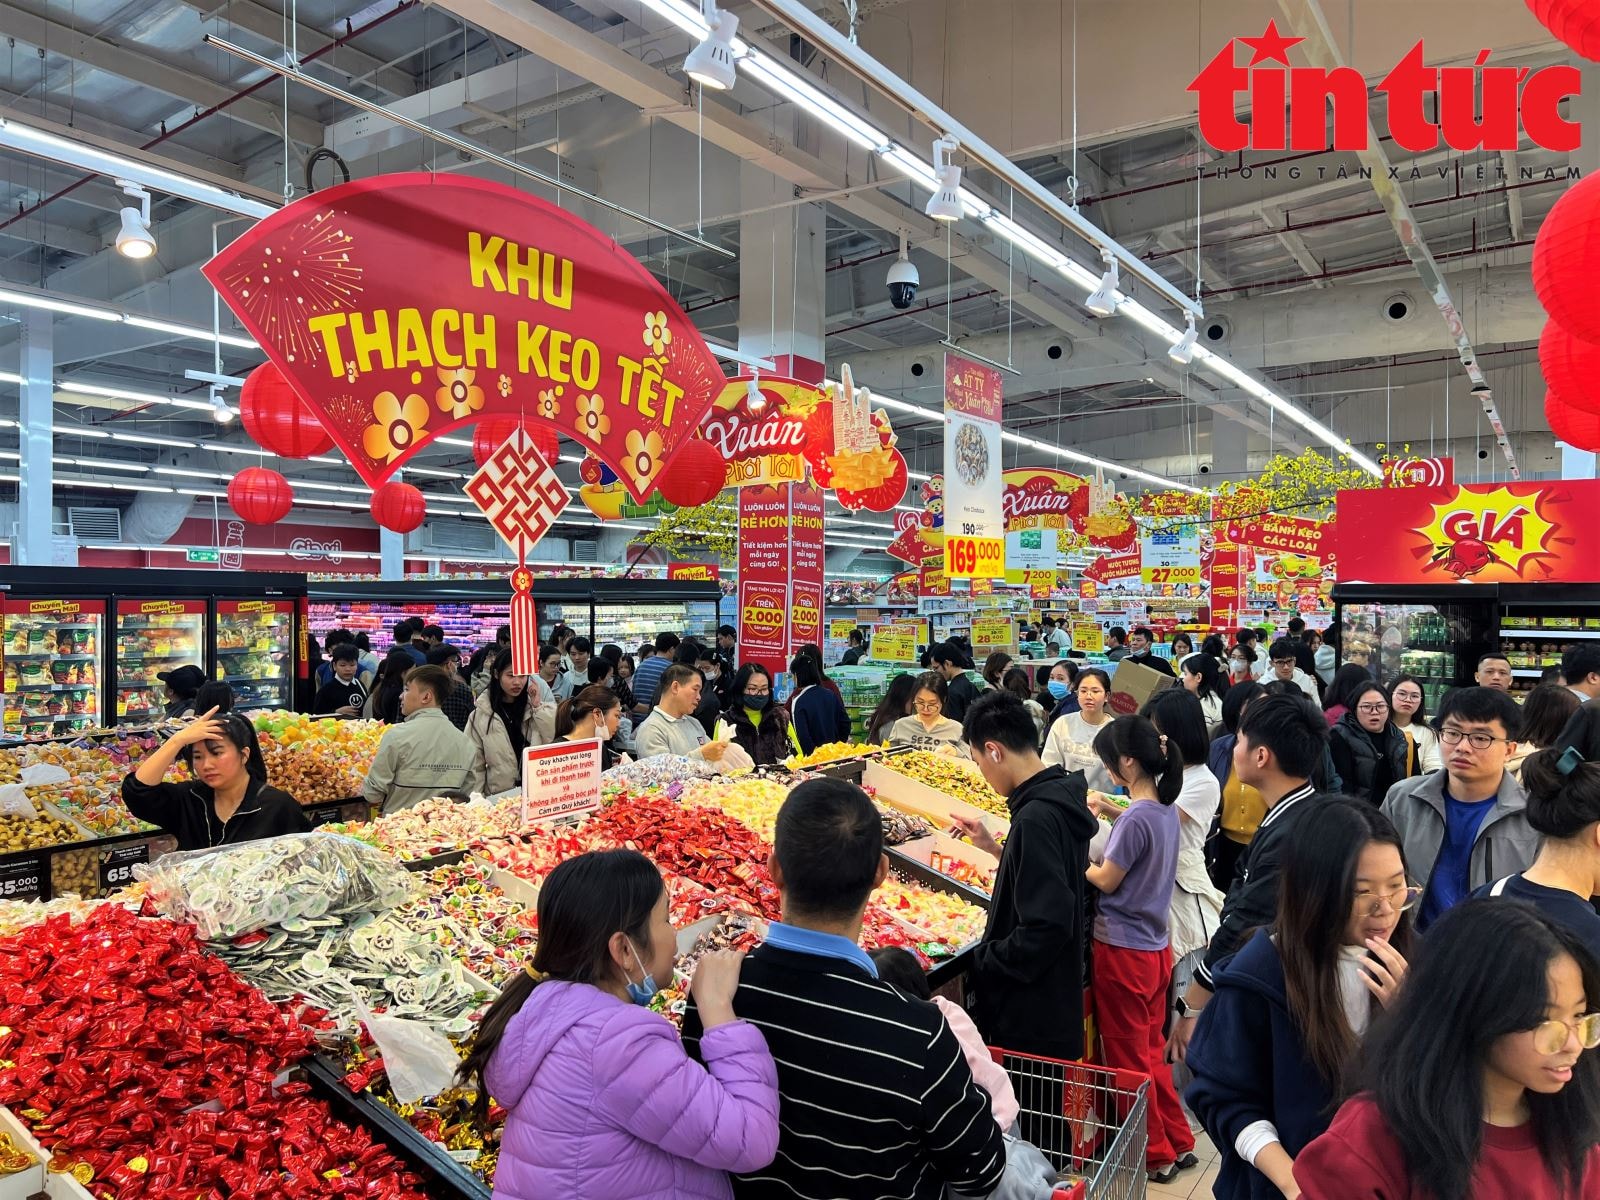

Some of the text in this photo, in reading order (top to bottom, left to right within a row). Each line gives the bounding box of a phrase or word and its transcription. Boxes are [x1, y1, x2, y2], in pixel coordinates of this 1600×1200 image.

[468, 231, 574, 311] KHU
[308, 308, 685, 428] THẠCH KẸO TẾT
[705, 410, 806, 460] Xuân
[725, 453, 796, 485] Phát Tài
[744, 502, 785, 512] LUÔN LUÔN
[793, 502, 821, 513] LUÔN LUÔN
[1003, 489, 1070, 516] Xuân
[741, 513, 788, 529] RẺ HƠN
[792, 512, 823, 530] RẺ HƠN
[1441, 505, 1530, 550] GIÁ
[1263, 522, 1322, 541] BÁNH KẸO
[743, 541, 787, 550] Tiết kiệm hơn
[1263, 535, 1317, 554] CÁC LOẠI
[749, 551, 762, 559] mỗi
[948, 538, 1001, 574] 169.000
[767, 560, 780, 568] GO!
[1107, 558, 1140, 569] NƯỚC TƯƠNG
[1023, 570, 1051, 583] 7.200
[1151, 568, 1195, 583] 27.000
[755, 599, 775, 608] TRÊN
[800, 599, 813, 607] TRÊN
[745, 610, 783, 624] 2.000
[793, 609, 818, 623] 2.000
